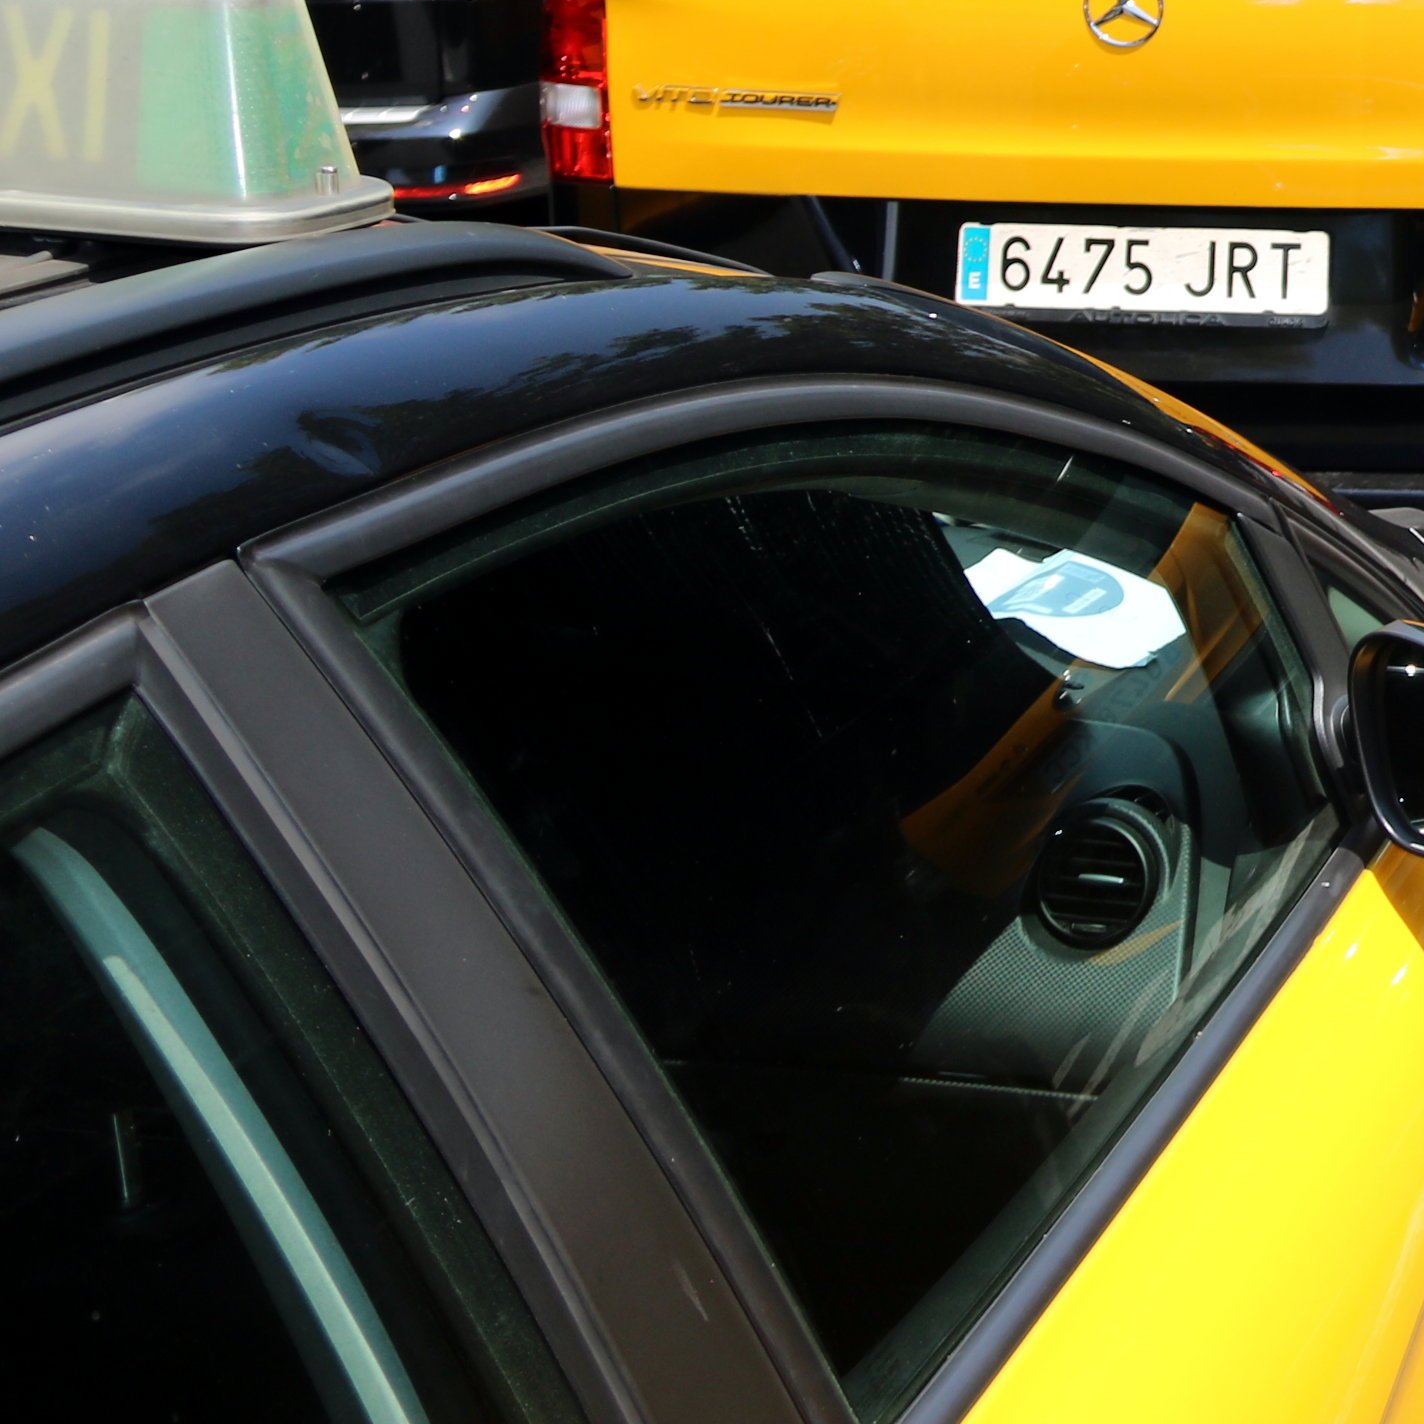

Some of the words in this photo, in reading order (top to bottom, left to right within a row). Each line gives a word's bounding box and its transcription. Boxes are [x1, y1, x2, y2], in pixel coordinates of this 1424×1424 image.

[0, 2, 111, 162] XI
[967, 271, 982, 290] E
[1000, 236, 1153, 295] 6475
[1184, 240, 1302, 300] JRT
